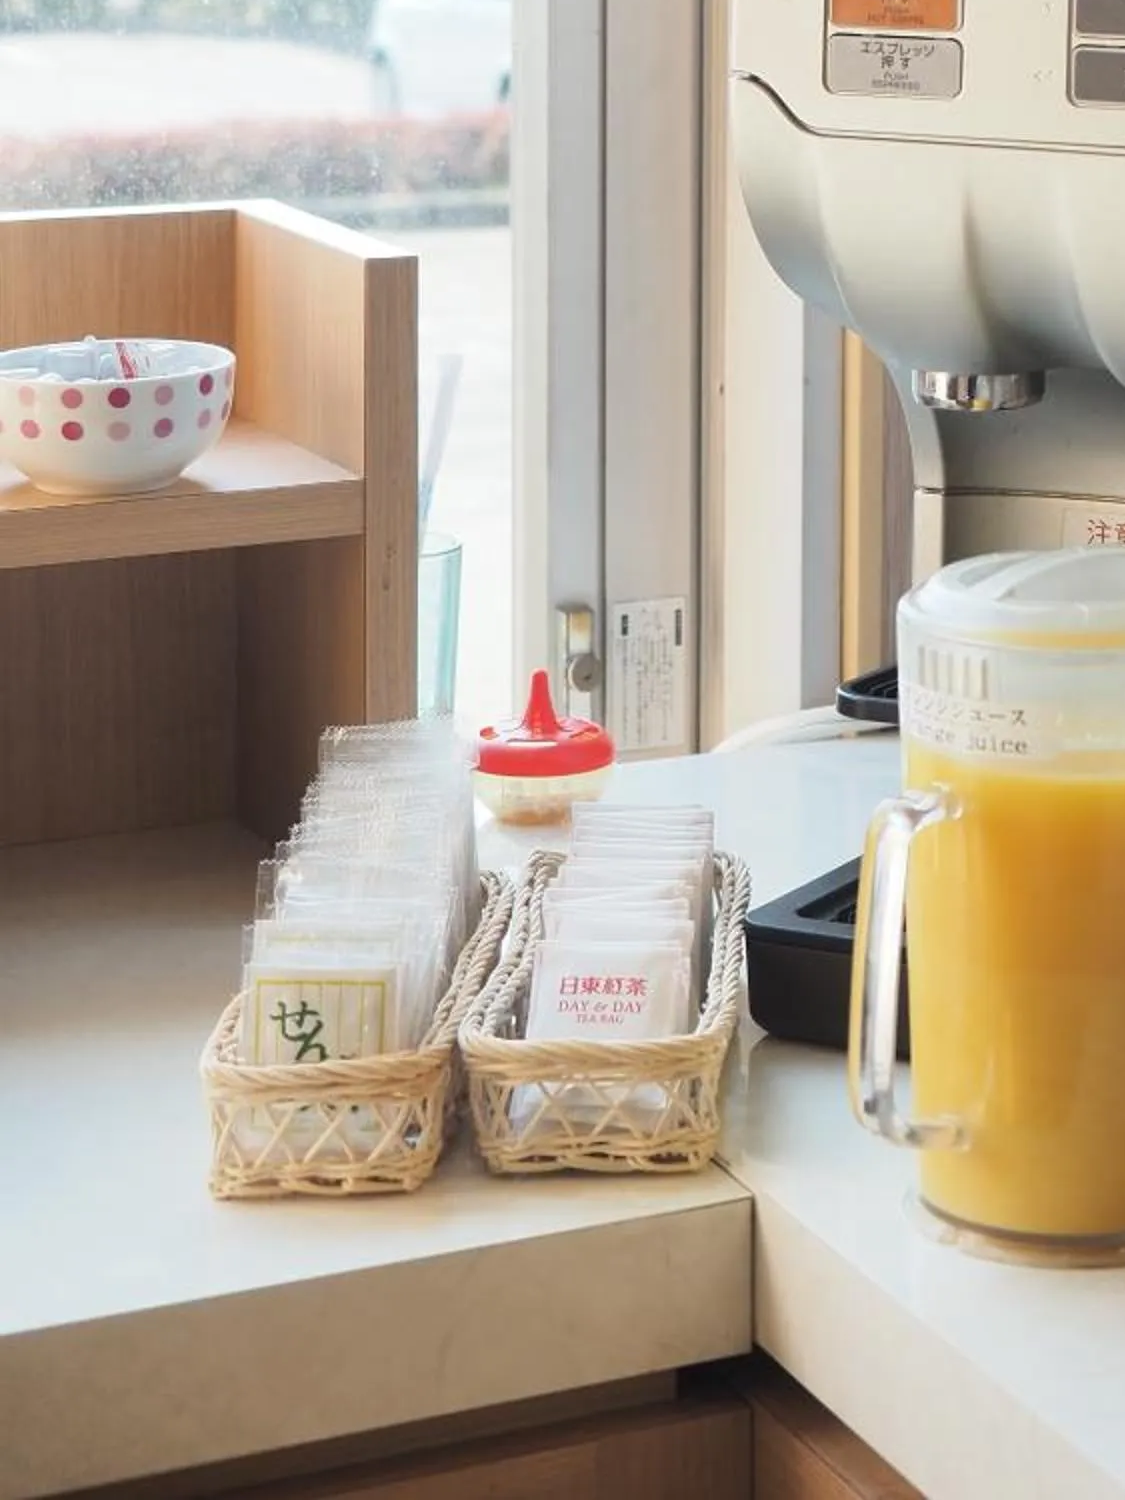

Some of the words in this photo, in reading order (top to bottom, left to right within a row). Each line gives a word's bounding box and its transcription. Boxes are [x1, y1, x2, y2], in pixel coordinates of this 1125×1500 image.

[861, 41, 935, 57] エスプレッソ
[559, 975, 649, 997] 日東紅茶
[557, 999, 590, 1013] DAY
[612, 1001, 644, 1013] DAY
